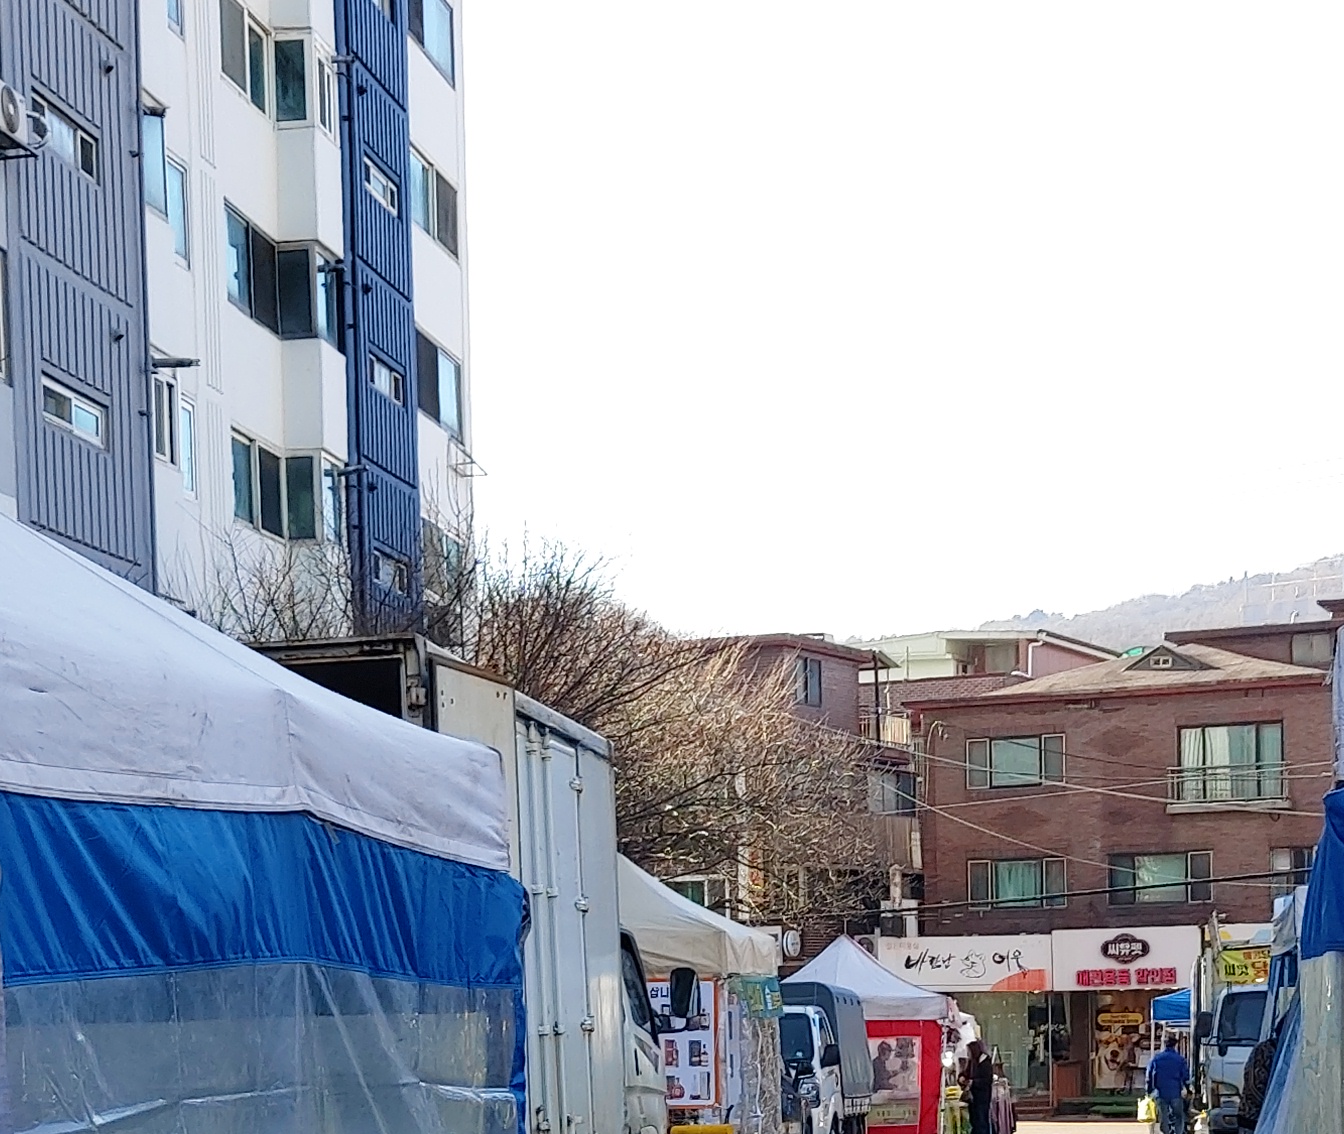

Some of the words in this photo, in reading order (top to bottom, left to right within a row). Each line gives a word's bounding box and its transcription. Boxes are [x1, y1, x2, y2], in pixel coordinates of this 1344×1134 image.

[1076, 968, 1131, 986] 애견용품
[1135, 967, 1176, 985] 할인점
[650, 986, 670, 999] 삽니
